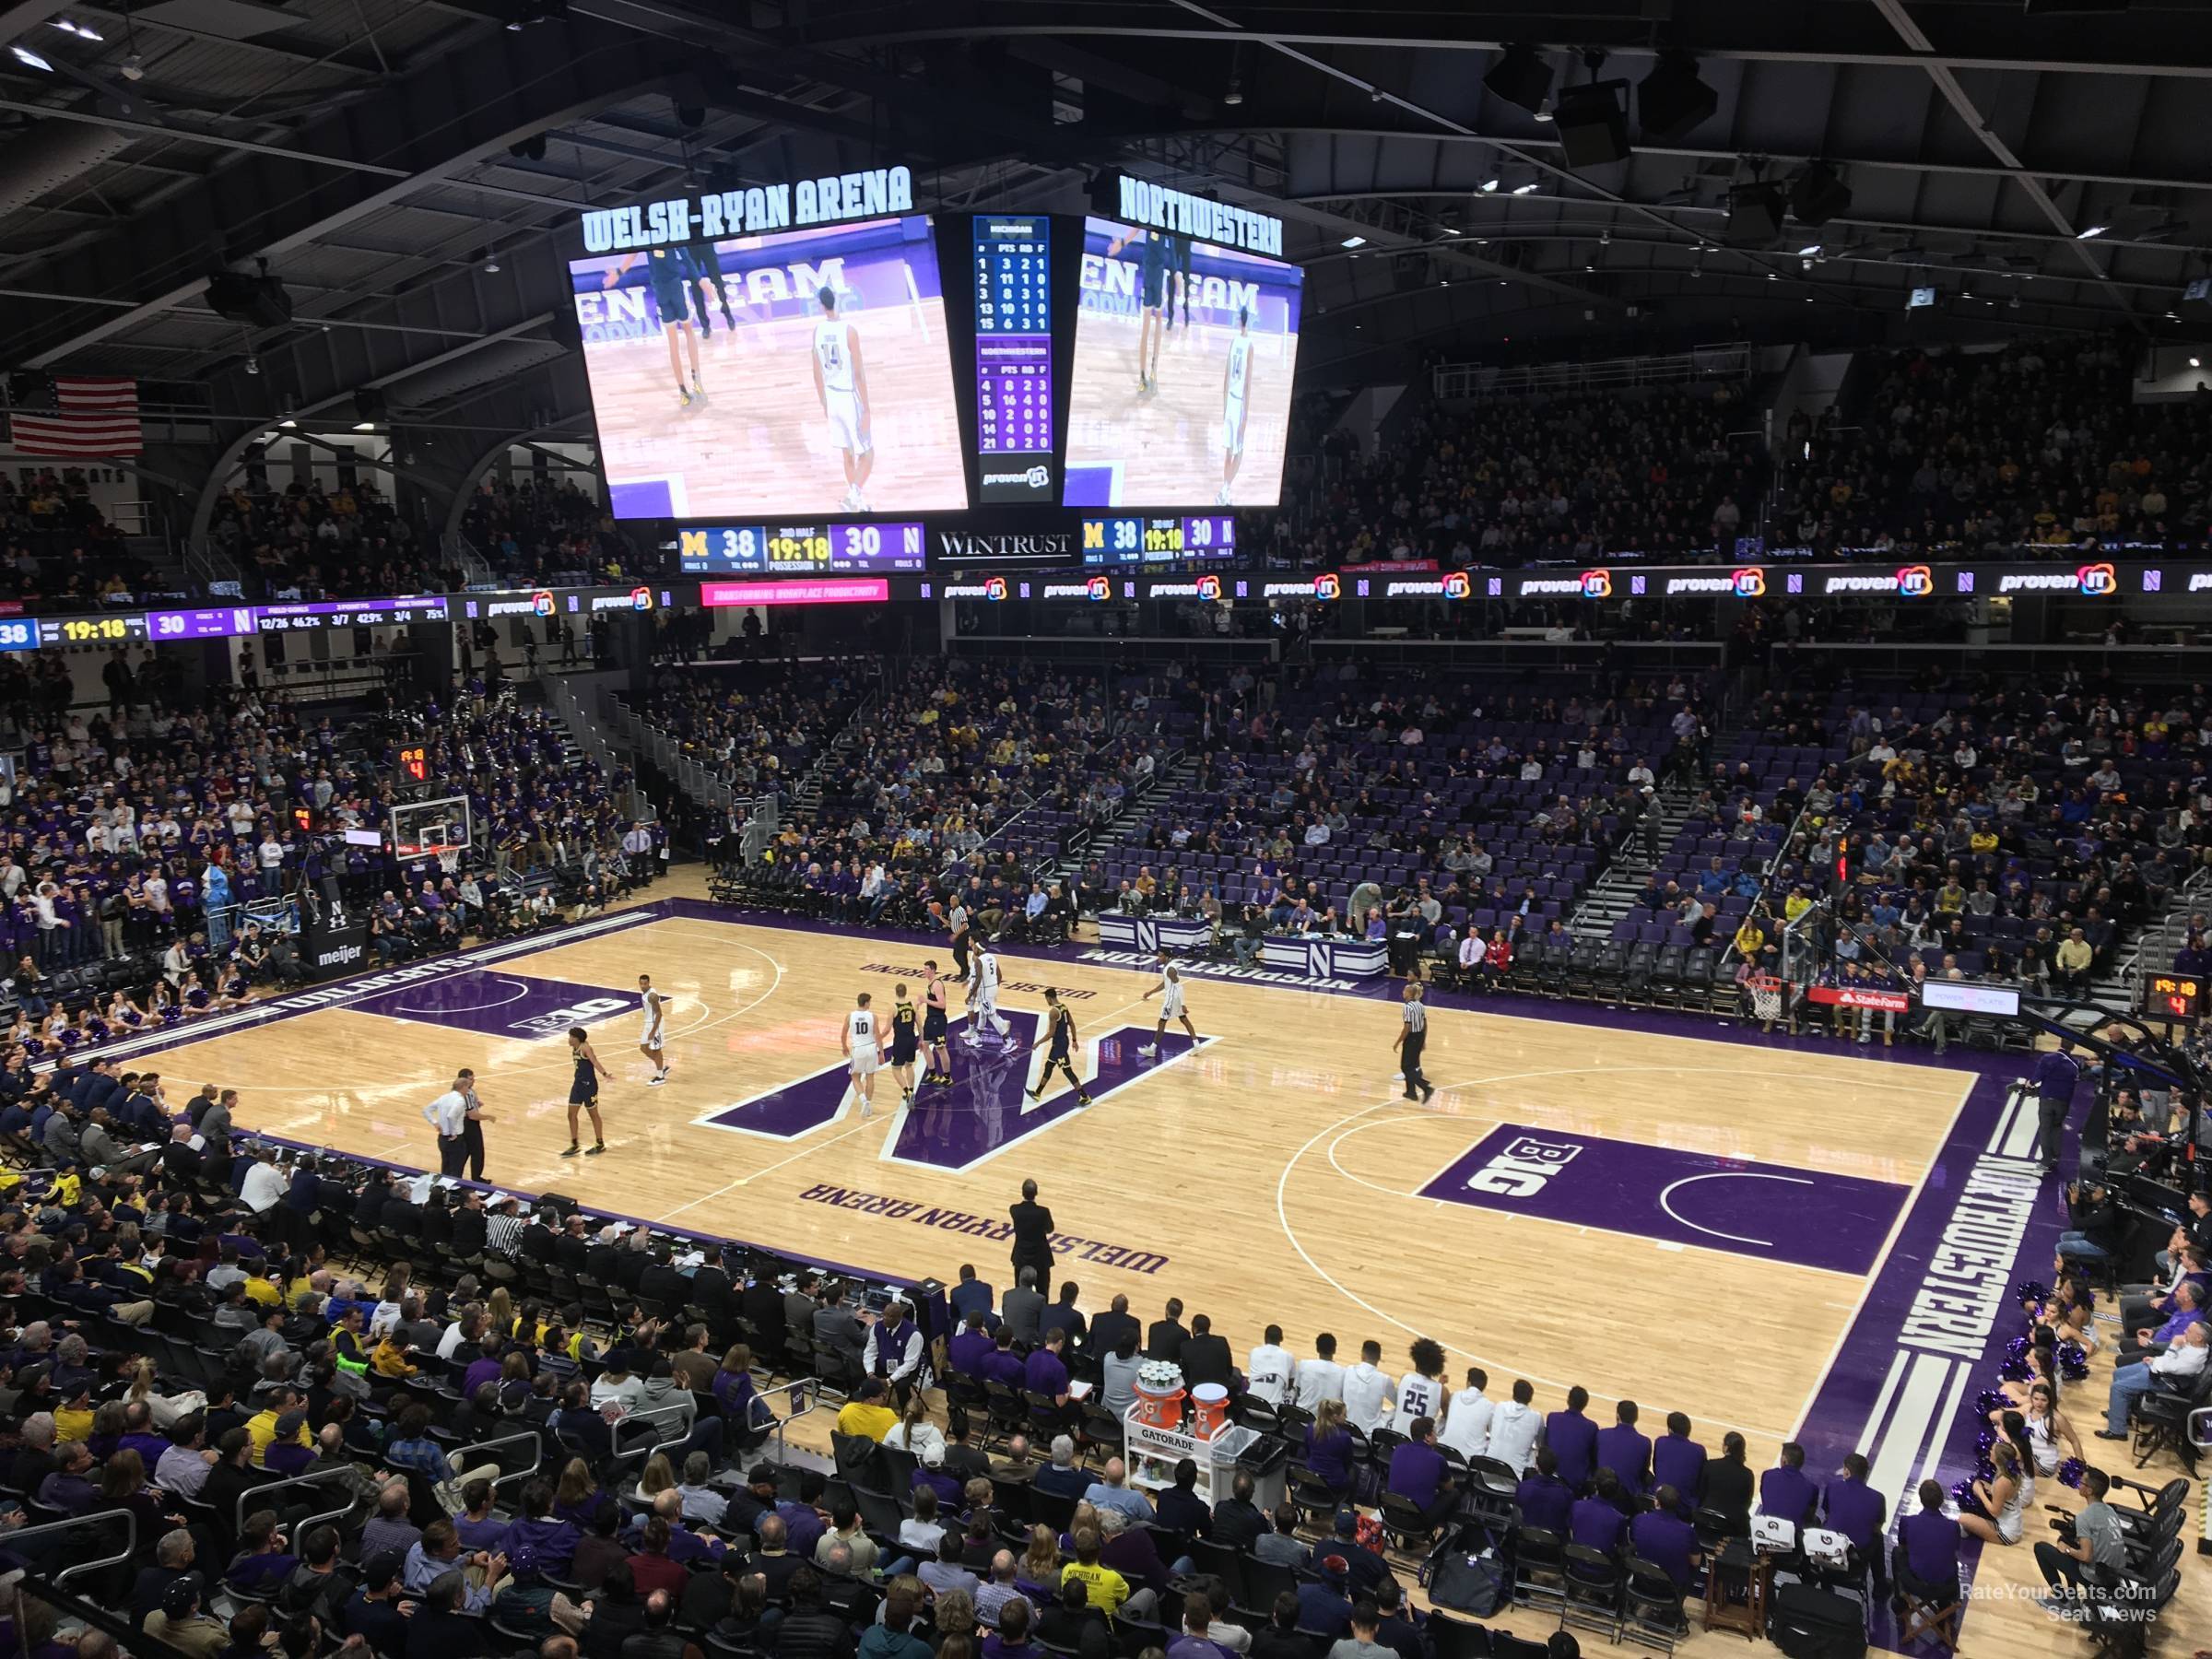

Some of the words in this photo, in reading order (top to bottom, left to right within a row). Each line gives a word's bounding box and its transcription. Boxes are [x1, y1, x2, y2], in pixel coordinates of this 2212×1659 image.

[582, 183, 790, 252] WELSH-RYAN
[795, 165, 913, 225] ARENA
[1119, 175, 1283, 256] NORTHWESTERN
[1038, 244, 1045, 253] F
[978, 258, 986, 269] 1
[1002, 258, 1011, 269] 3
[1021, 258, 1030, 269] 2
[1037, 258, 1044, 269] 1
[979, 273, 988, 285] 2
[1000, 274, 1014, 285] 11
[1021, 274, 1030, 285] 1
[1037, 274, 1046, 285] 0
[1079, 253, 1139, 296] EN
[979, 288, 988, 300] 3
[1003, 288, 1012, 300] 8
[1021, 288, 1030, 300] 3
[1037, 288, 1045, 300] 1
[574, 286, 646, 324] EN
[980, 302, 994, 314] 13
[1000, 302, 1015, 314] 10
[1022, 303, 1030, 314] 1
[1038, 303, 1046, 314] 0
[980, 318, 994, 329] 15
[1004, 318, 1013, 329] 6
[1022, 318, 1030, 329] 3
[1038, 318, 1046, 329] 1
[982, 380, 991, 392] 4
[1005, 380, 1014, 392] 8
[1023, 380, 1032, 392] 2
[1039, 380, 1047, 391] 3
[982, 394, 992, 406] 5
[1003, 394, 1017, 406] 16
[1023, 394, 1032, 406] 4
[1039, 394, 1048, 406] 0
[982, 408, 996, 420] 10
[1006, 408, 1015, 420] 2
[1023, 408, 1033, 420] 0
[1039, 408, 1048, 420] 0
[982, 423, 996, 435] 14
[1006, 423, 1015, 435] 4
[1024, 423, 1033, 434] 0
[1040, 422, 1048, 434] 2
[982, 437, 996, 449] 21
[1006, 437, 1016, 449] 0
[1024, 437, 1033, 449] 2
[1040, 437, 1049, 449] 0
[1083, 522, 1104, 548] M
[1113, 521, 1136, 549] 38
[1145, 528, 1182, 550] 19:18
[1191, 519, 1212, 546] 30
[1222, 520, 1232, 544] N
[680, 531, 709, 557] M
[722, 529, 756, 558] 38
[769, 537, 829, 560] 19:18
[845, 526, 881, 557] 30
[903, 527, 920, 554] N
[938, 531, 1071, 555] WINTRUST
[769, 560, 815, 571] POSSESSION
[1357, 580, 1369, 595] N
[1488, 578, 1501, 595] N
[1631, 575, 1646, 594] N
[1788, 574, 1803, 593] N
[1958, 571, 1974, 592] N
[2143, 570, 2161, 591] N
[921, 583, 931, 597] N
[1020, 582, 1030, 597] N
[1124, 582, 1135, 597] N
[1236, 582, 1247, 596] N
[0, 624, 29, 644] 38
[63, 619, 125, 641] 19:18
[158, 616, 184, 634] 30
[233, 608, 251, 632] N
[260, 618, 288, 629] 12/26
[292, 617, 321, 629] 46.2%
[331, 615, 349, 626] 3/7
[357, 613, 383, 624] 42.9%
[394, 611, 411, 622] 3/4
[426, 609, 444, 619] 75%
[409, 761, 424, 780] 4
[332, 900, 342, 915] N
[1136, 922, 1159, 951] N
[319, 945, 362, 966] meijer
[1310, 943, 1330, 977] N
[988, 962, 995, 975] 5
[1077, 949, 1359, 990] NUSPORTSCOM
[279, 956, 473, 1008] WILDCATS
[2170, 997, 2186, 1015] 4
[900, 1010, 913, 1023] 13
[855, 1021, 869, 1035] 10
[800, 1183, 923, 1218] ARENA
[1897, 1153, 2043, 1360] NORTHWESTERN
[793, 1392, 803, 1406] 107
[1403, 1389, 1429, 1417] 25
[1144, 1401, 1155, 1415] G
[1197, 1409, 1208, 1423] G
[1141, 1429, 1195, 1452] GATORADE
[1067, 1569, 1101, 1582] MICHIGAN
